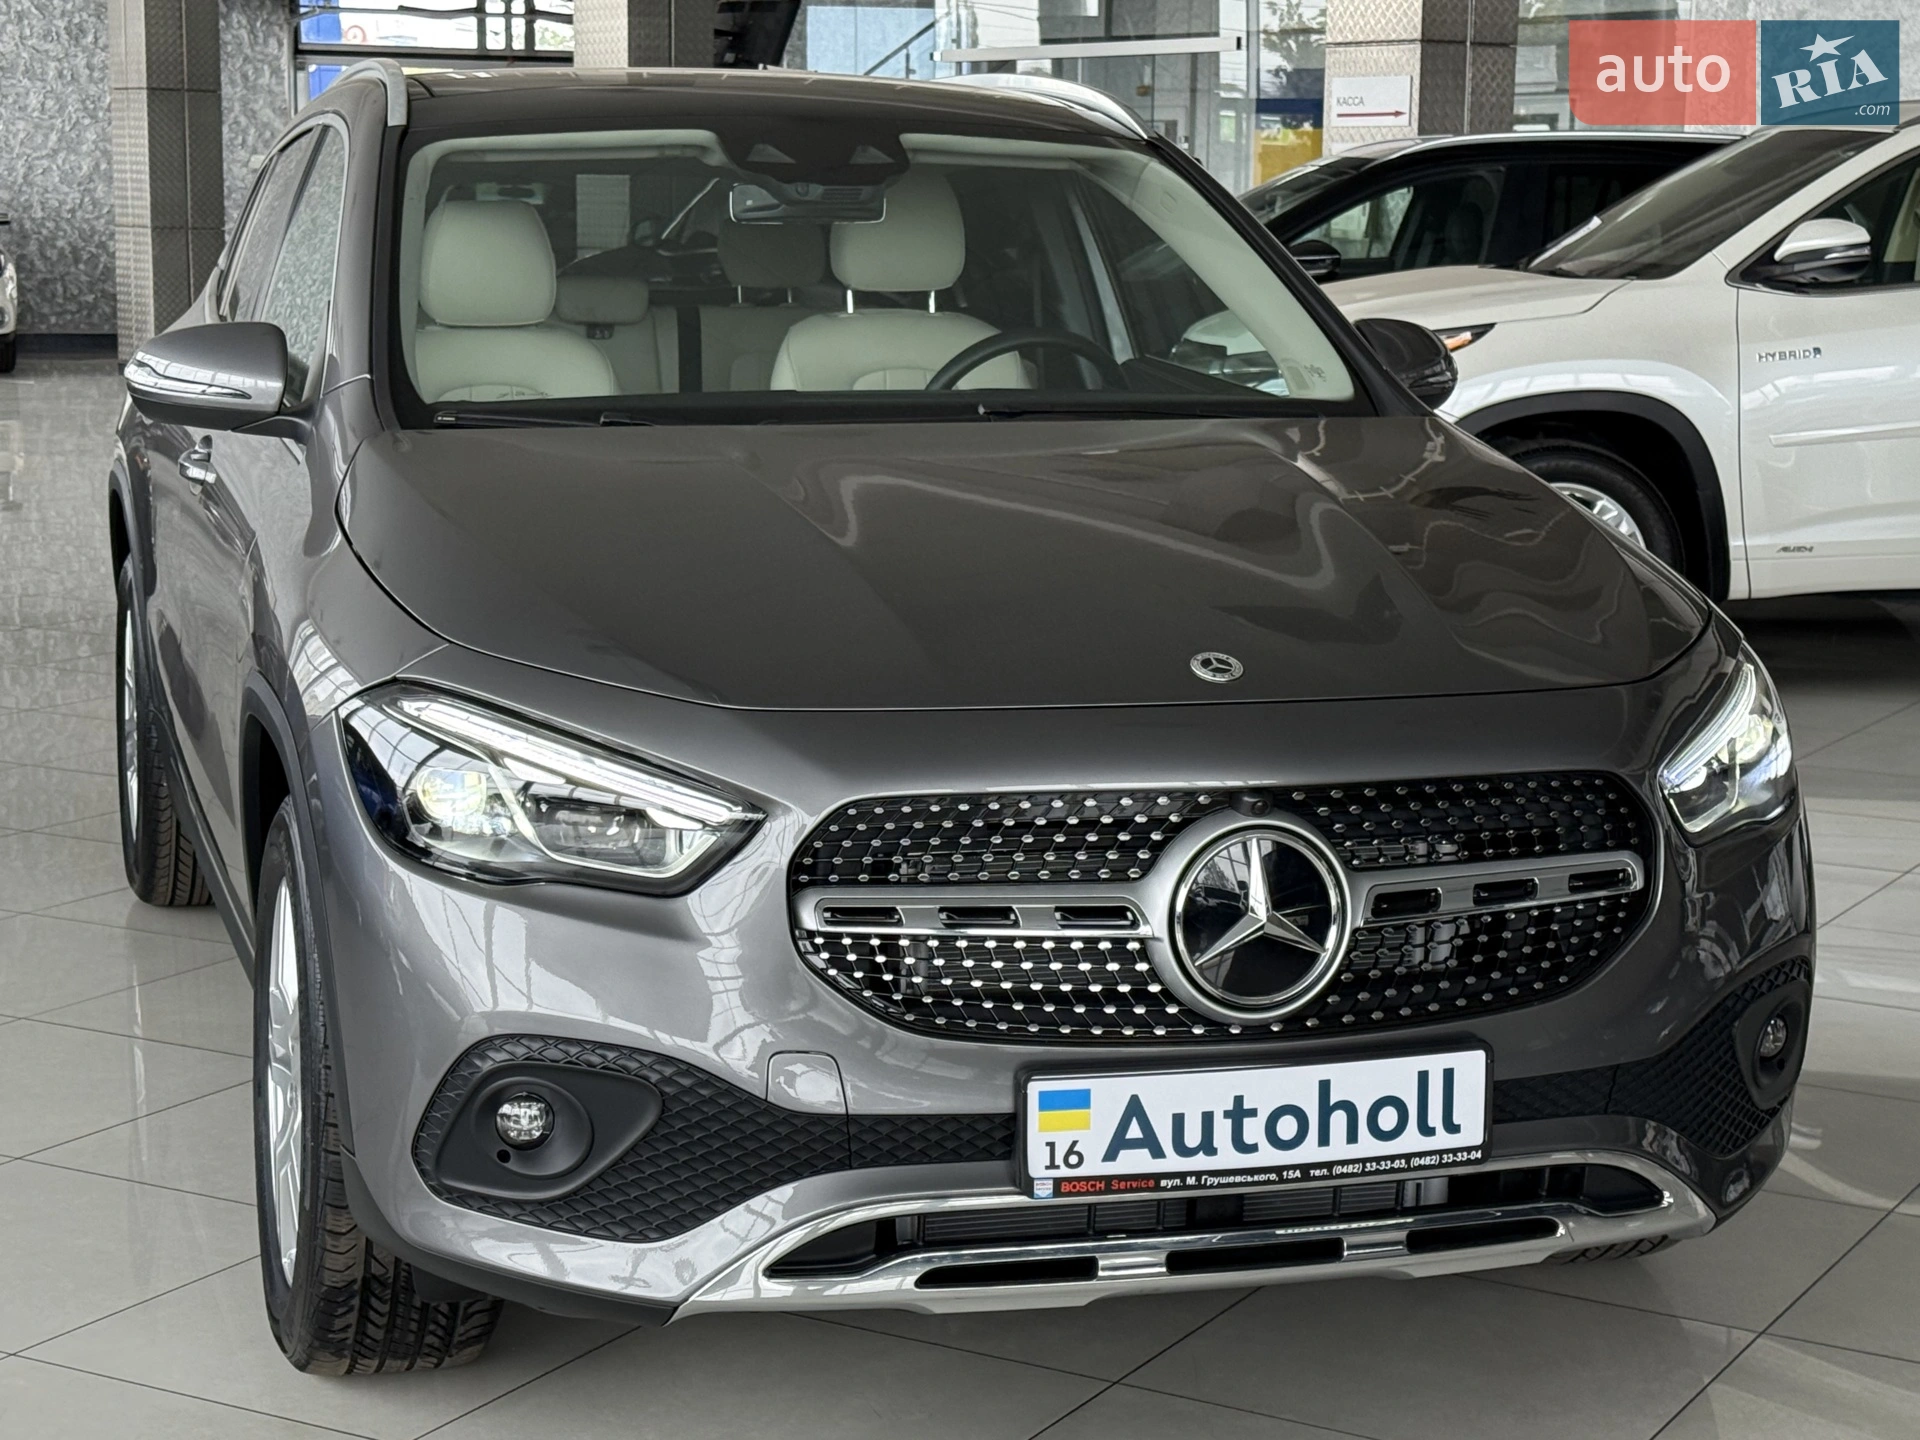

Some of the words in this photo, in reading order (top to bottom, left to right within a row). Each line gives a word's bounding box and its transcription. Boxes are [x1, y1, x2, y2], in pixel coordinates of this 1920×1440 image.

[1336, 96, 1365, 106] КАССА
[1756, 349, 1812, 362] HYBRID
[1101, 1068, 1462, 1163] Autoholl
[1044, 1140, 1085, 1170] 16
[1061, 1180, 1105, 1192] BOSCH
[1111, 1179, 1155, 1190] Service
[1160, 1179, 1183, 1188] вул.
[1186, 1176, 1199, 1185] М.
[1201, 1173, 1279, 1186] Грушевського,
[1332, 1162, 1362, 1176] (0482)
[1364, 1158, 1408, 1171] 33-33-03,
[1410, 1153, 1440, 1168] (0482)
[1441, 1149, 1482, 1164] 33-33-04
